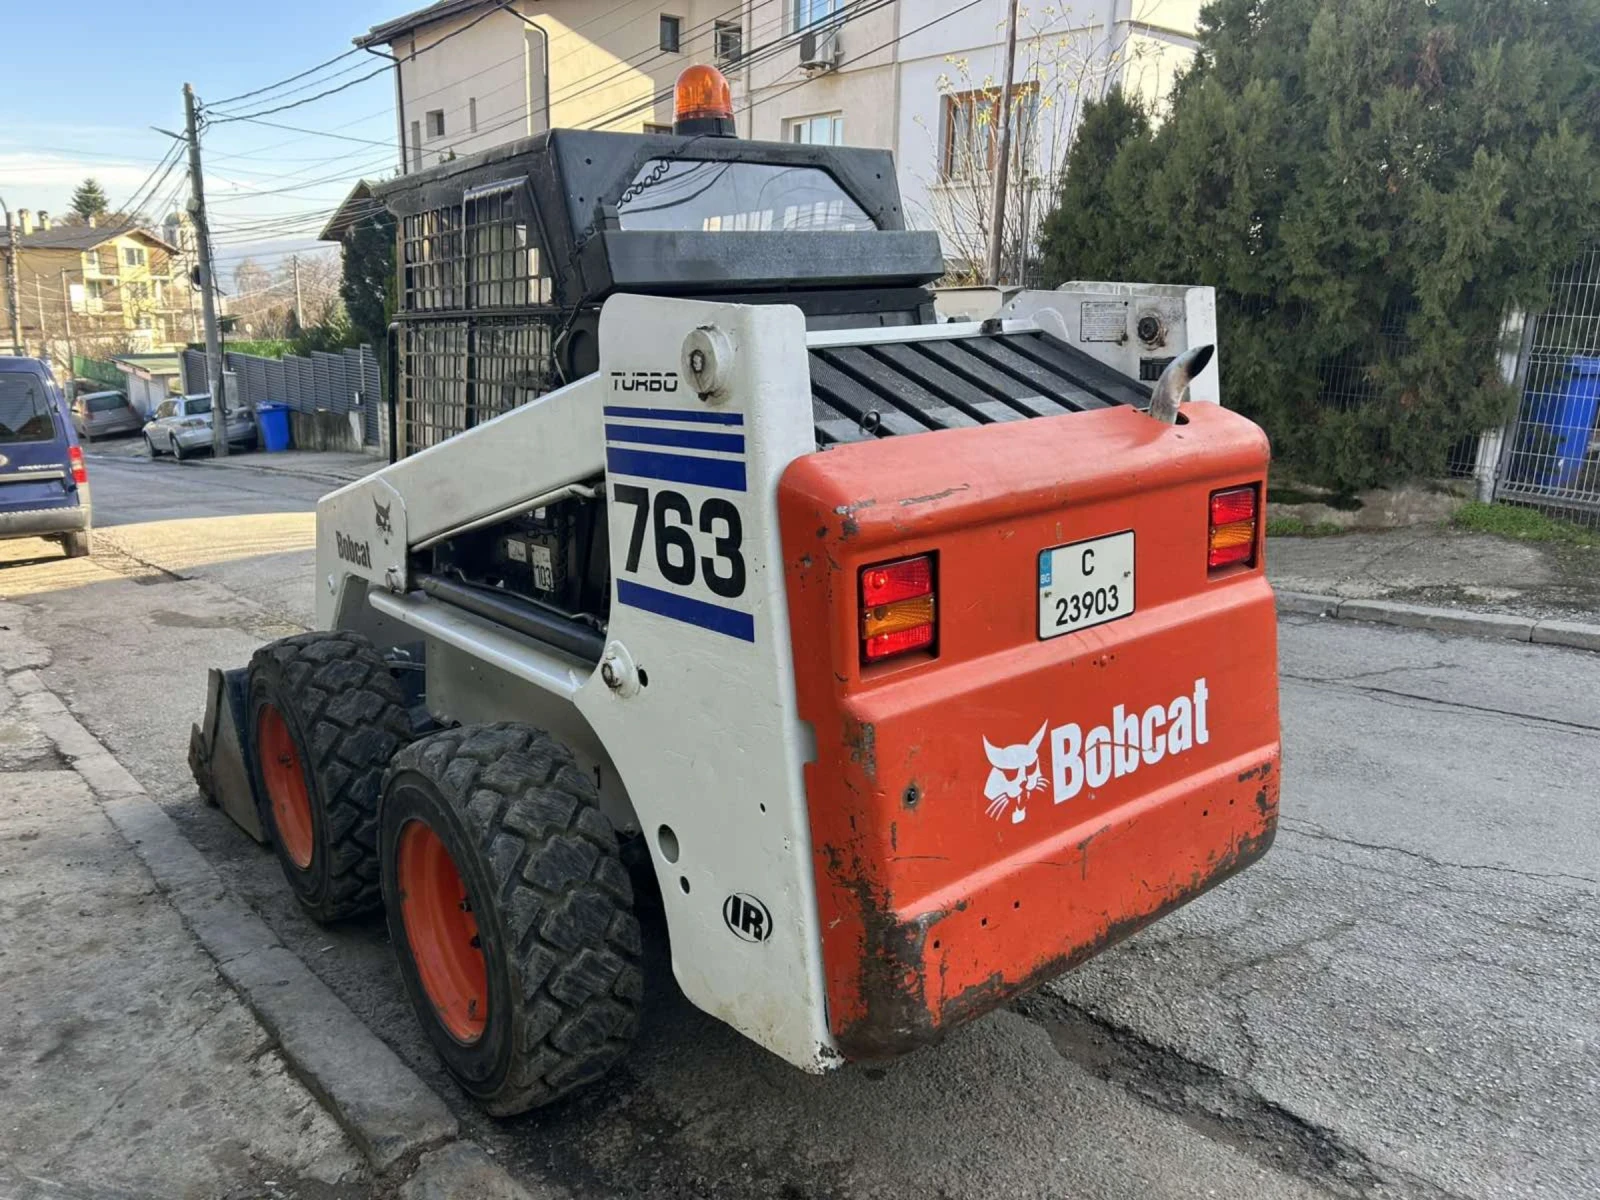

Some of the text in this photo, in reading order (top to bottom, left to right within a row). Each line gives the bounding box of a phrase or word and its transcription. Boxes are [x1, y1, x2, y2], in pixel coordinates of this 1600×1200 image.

[610, 371, 678, 392] TURBO
[336, 530, 372, 569] Bobcat
[613, 483, 746, 598] 763
[536, 564, 552, 587] 103
[1040, 573, 1050, 584] BG
[1081, 549, 1094, 576] C
[1055, 585, 1119, 626] 23903
[1051, 677, 1209, 804] Bobcat
[730, 894, 764, 942] IR
